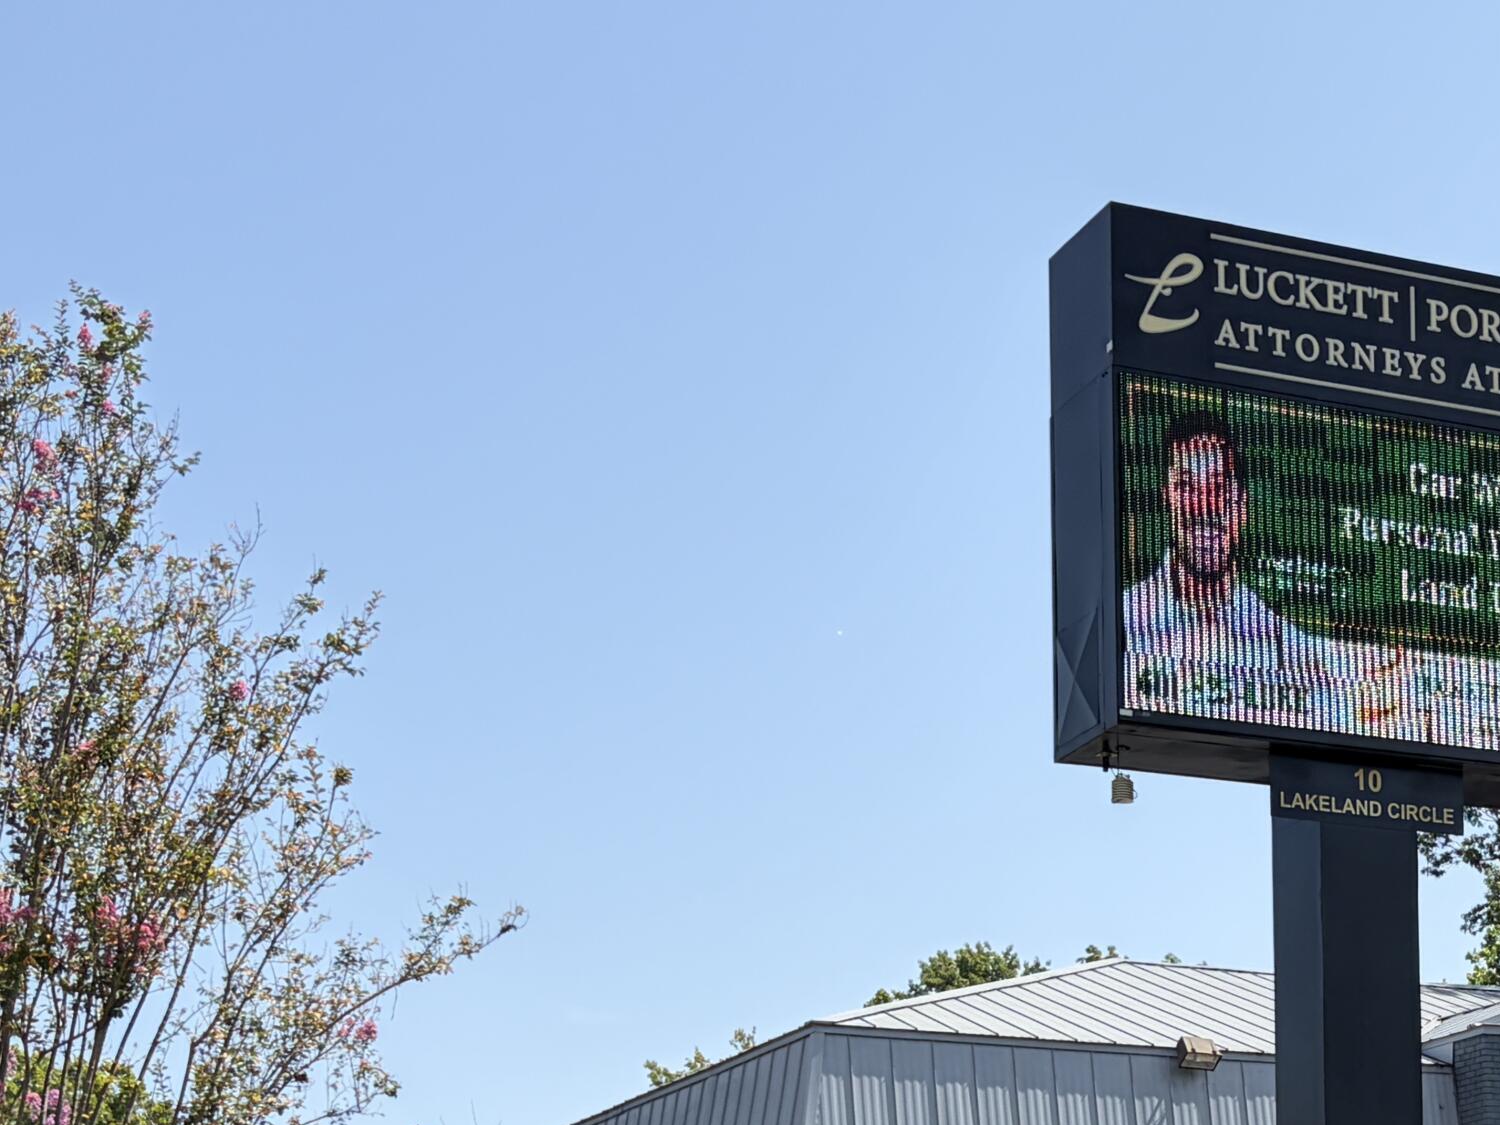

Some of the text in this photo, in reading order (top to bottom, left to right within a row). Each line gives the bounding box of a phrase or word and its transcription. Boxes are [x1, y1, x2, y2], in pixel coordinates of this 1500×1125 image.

[1213, 258, 1399, 325] LUCKETT
[1214, 319, 1447, 385] ATTORNEYS
[1410, 462, 1462, 499] Car
[1340, 506, 1479, 557] Personal
[1401, 568, 1478, 611] Land
[1354, 768, 1382, 793] 10
[1280, 791, 1455, 825] LAKELAND CIRCLE
